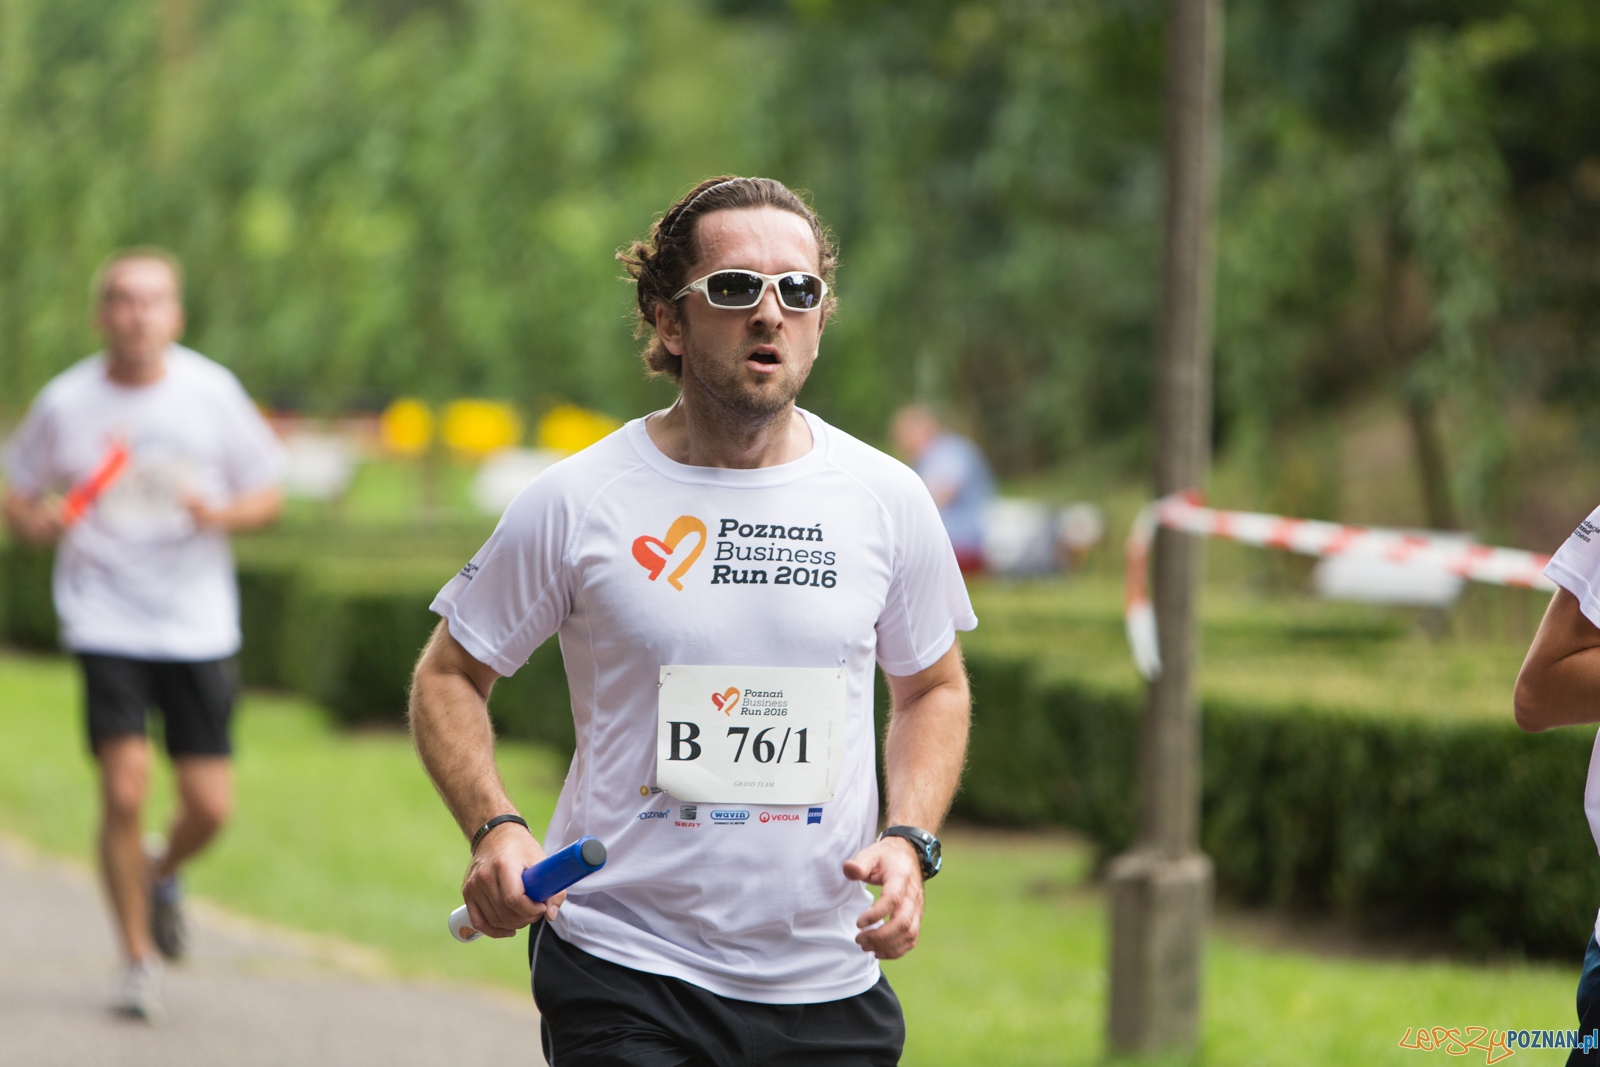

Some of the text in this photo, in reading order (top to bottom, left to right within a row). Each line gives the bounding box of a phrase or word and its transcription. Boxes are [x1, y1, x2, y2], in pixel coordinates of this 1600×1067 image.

[718, 518, 823, 541] Poznań
[714, 541, 836, 565] Business
[711, 564, 838, 588] Run 2016
[744, 689, 783, 698] Poznań
[742, 698, 788, 707] Business
[740, 707, 788, 716] Run 2016
[665, 721, 702, 761] B
[726, 727, 811, 764] 76/1
[714, 810, 746, 818] wavin
